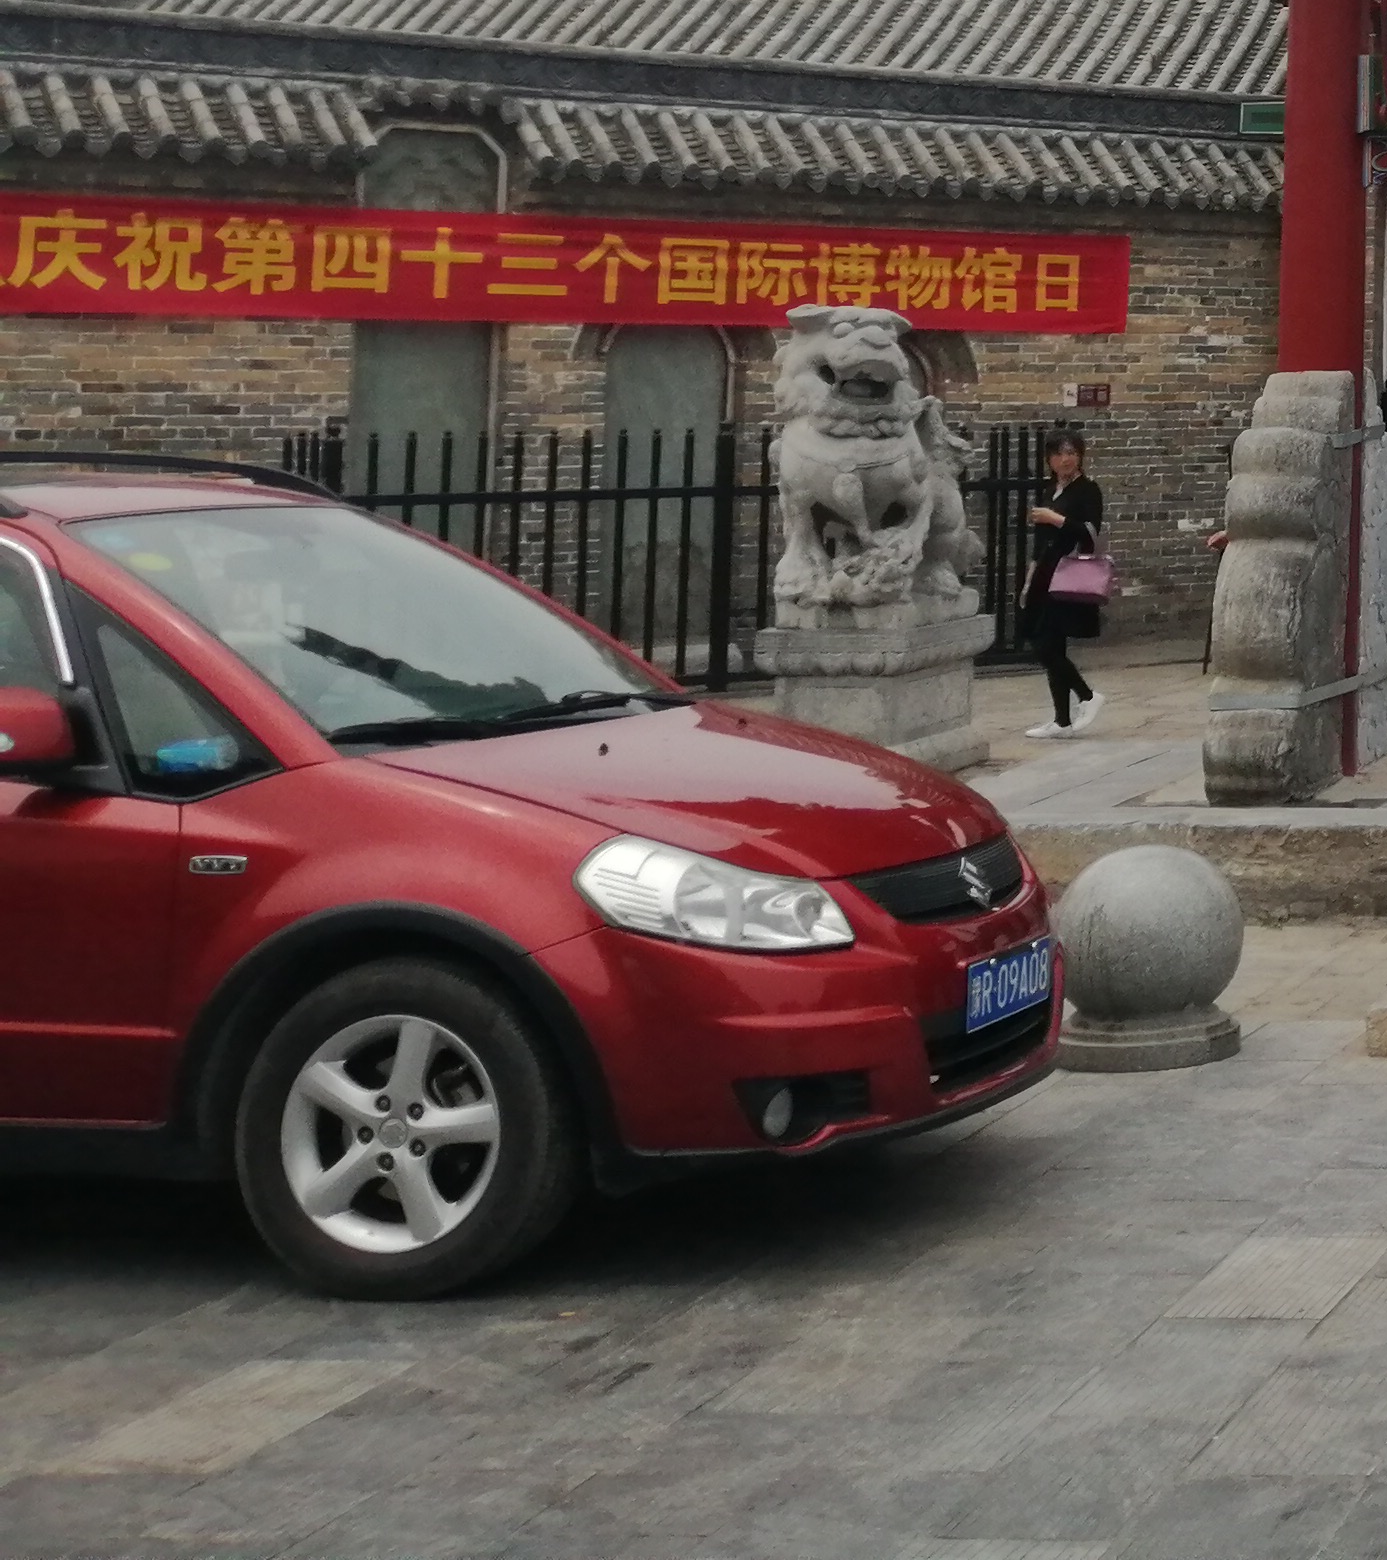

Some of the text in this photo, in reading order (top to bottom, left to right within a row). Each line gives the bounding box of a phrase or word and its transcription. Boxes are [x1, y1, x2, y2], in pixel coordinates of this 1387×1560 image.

[0, 208, 1082, 314] 庆祝第四十三个国际博物馆日
